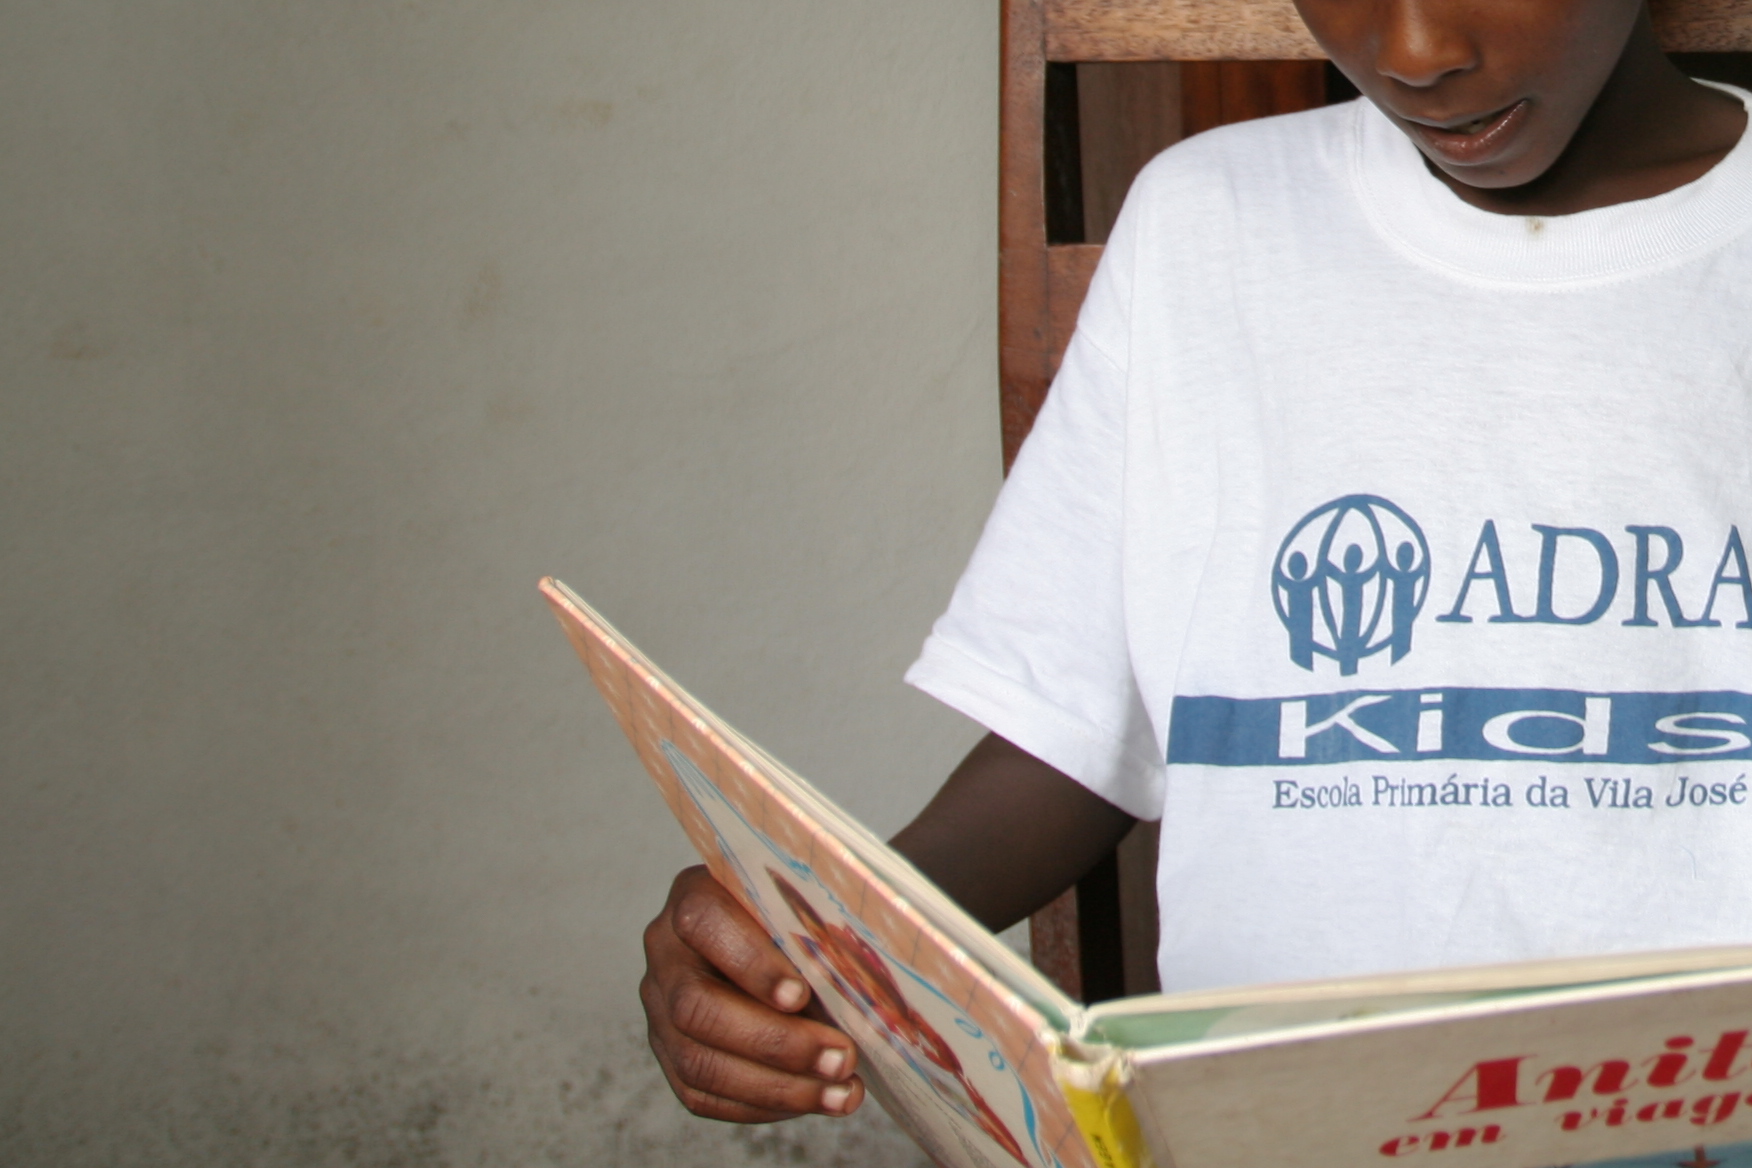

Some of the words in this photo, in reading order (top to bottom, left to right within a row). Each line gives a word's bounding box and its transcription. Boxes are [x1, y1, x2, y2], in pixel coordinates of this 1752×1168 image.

[1278, 693, 1752, 758] Kids
[1272, 778, 1364, 810] Escola
[1371, 772, 1514, 808] Primária
[1525, 775, 1571, 809] da
[1584, 776, 1655, 810] Vila
[1665, 773, 1749, 808] José
[1379, 1123, 1506, 1158] em
